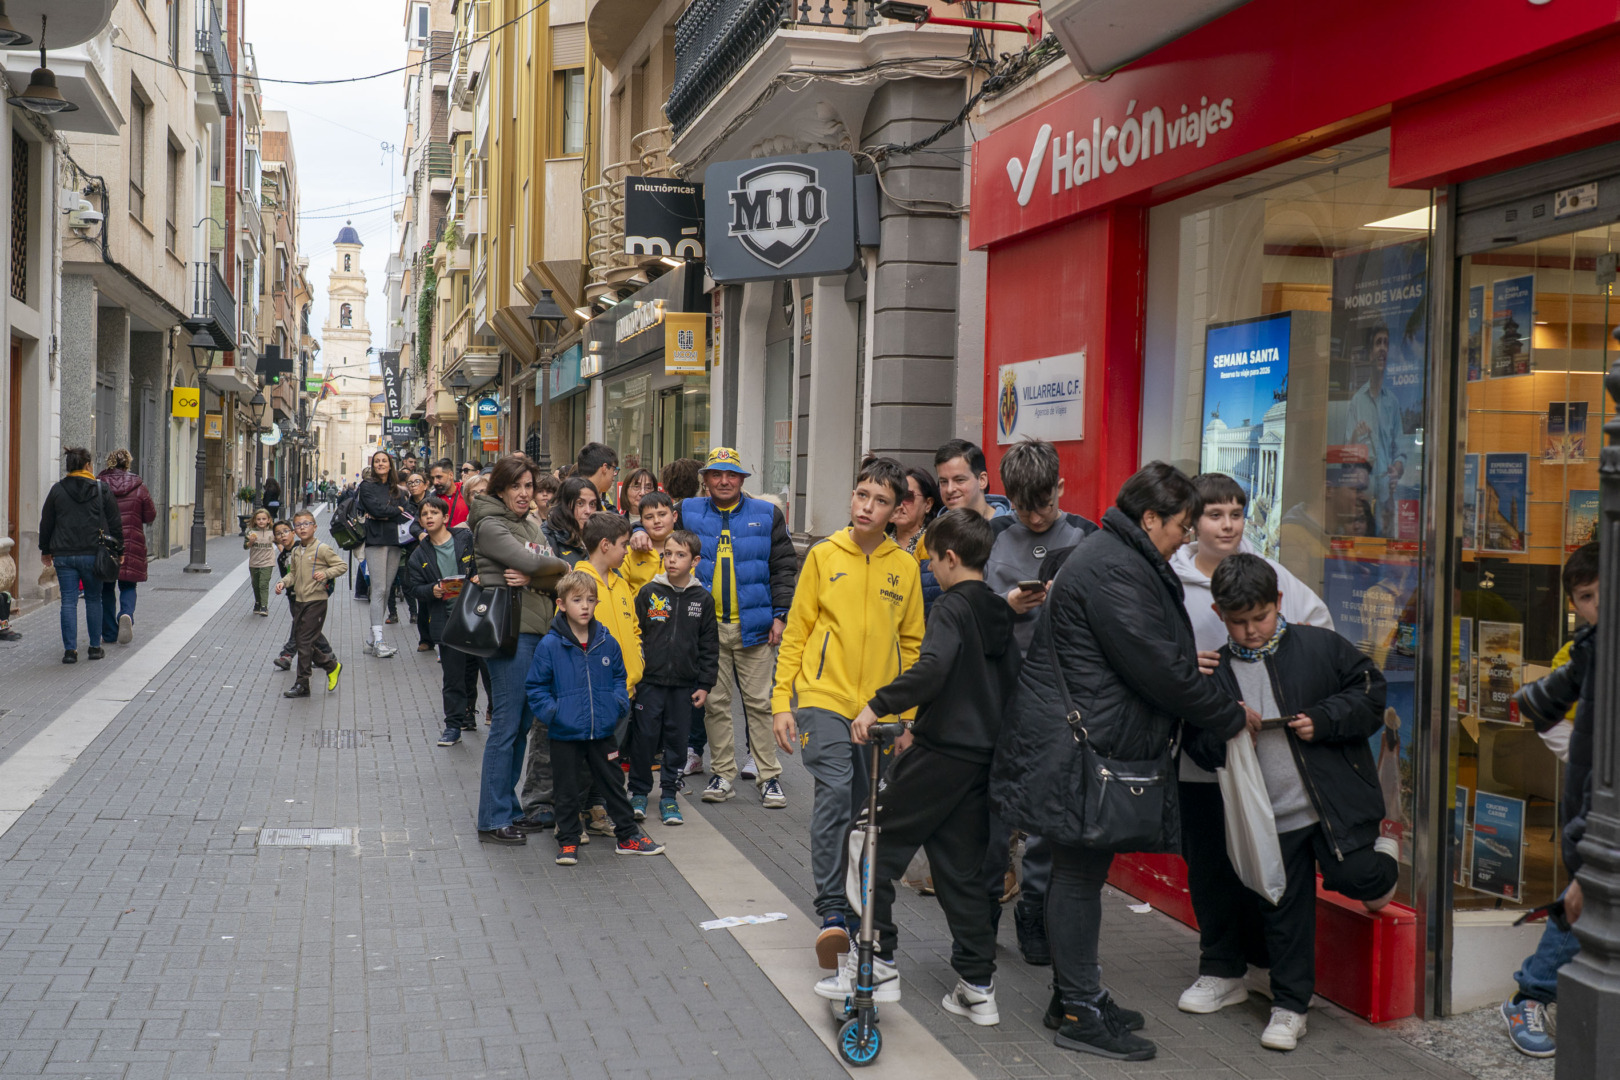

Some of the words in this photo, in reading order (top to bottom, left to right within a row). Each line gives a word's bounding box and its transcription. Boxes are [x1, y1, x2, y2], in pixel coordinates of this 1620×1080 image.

[1051, 100, 1164, 195] Halcón
[1166, 96, 1234, 149] viajes
[728, 184, 829, 237] M10
[1344, 295, 1372, 310] MONO
[1374, 290, 1388, 304] DE
[1390, 284, 1422, 302] VACAS
[1213, 352, 1248, 368] SEMANA
[1249, 347, 1279, 364] SANTA
[1022, 382, 1066, 401] VILLARREAL
[1067, 379, 1081, 396] C.F.
[1034, 407, 1050, 419] Agencia
[1050, 407, 1055, 415] de
[1055, 406, 1067, 417] Viajes
[1342, 601, 1348, 609] TE
[1340, 613, 1348, 622] EN
